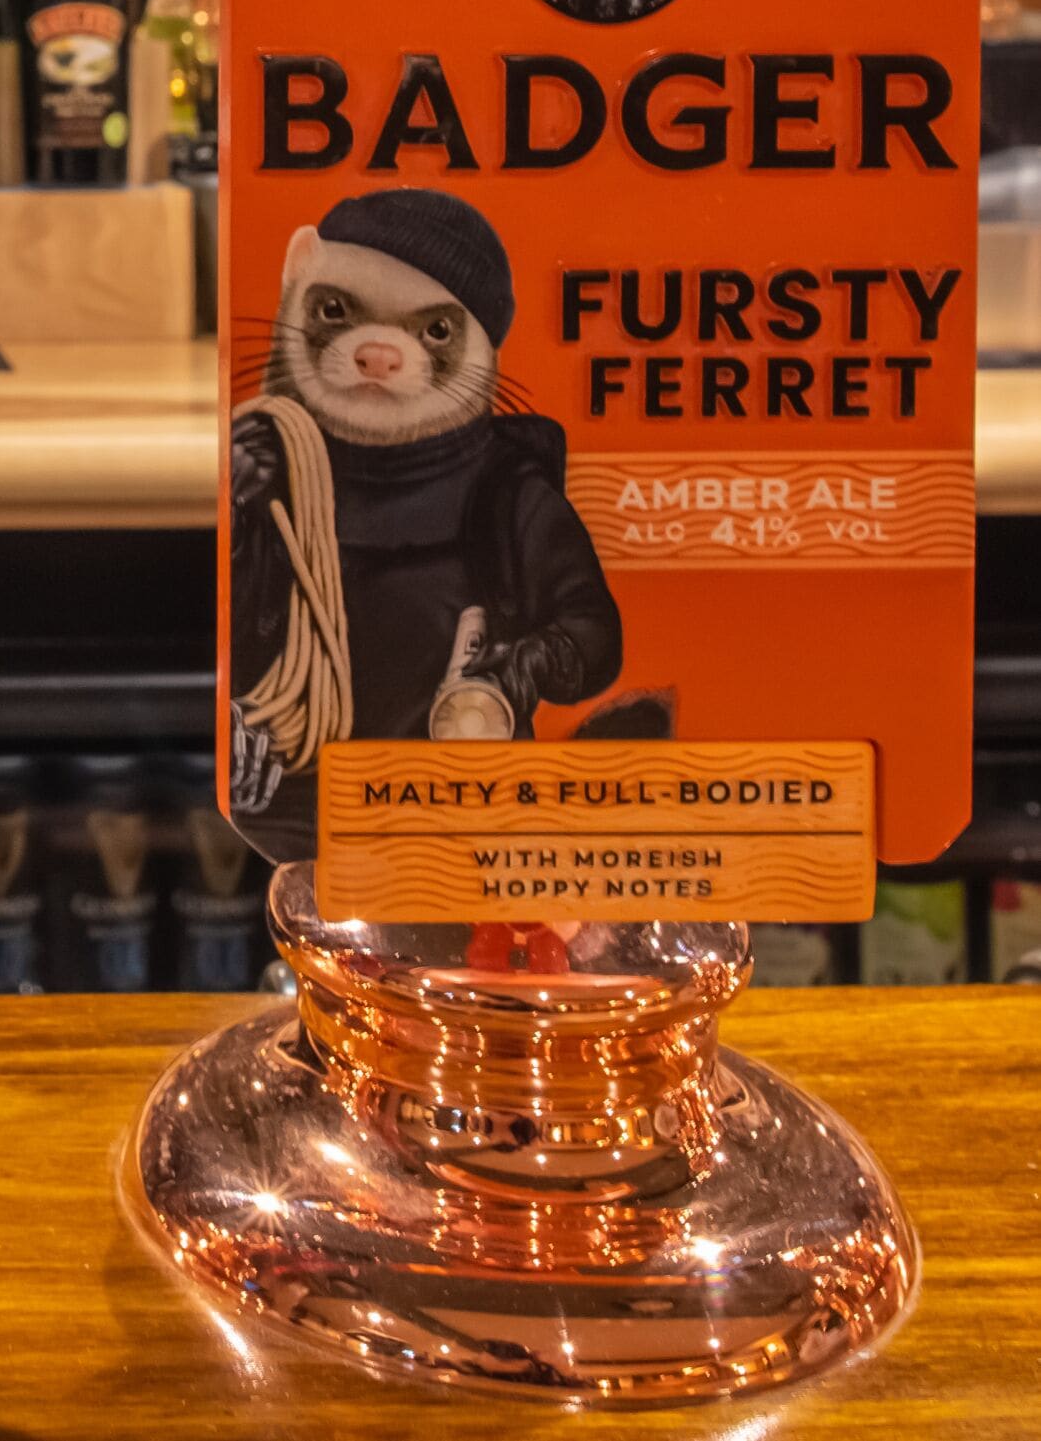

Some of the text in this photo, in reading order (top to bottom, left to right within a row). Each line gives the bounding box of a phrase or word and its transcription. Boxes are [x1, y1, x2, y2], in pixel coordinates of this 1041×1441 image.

[258, 53, 959, 172] BADGER
[562, 269, 962, 342] FURSTY
[589, 356, 932, 418] FERRET
[615, 477, 898, 511] AMBER ALE
[622, 515, 890, 547] ALC 4.1% VOL
[364, 779, 834, 805] MALTY & FULL-BODIED
[474, 849, 723, 868] WITH MOREISH
[483, 878, 713, 898] HOPPY NOTES
